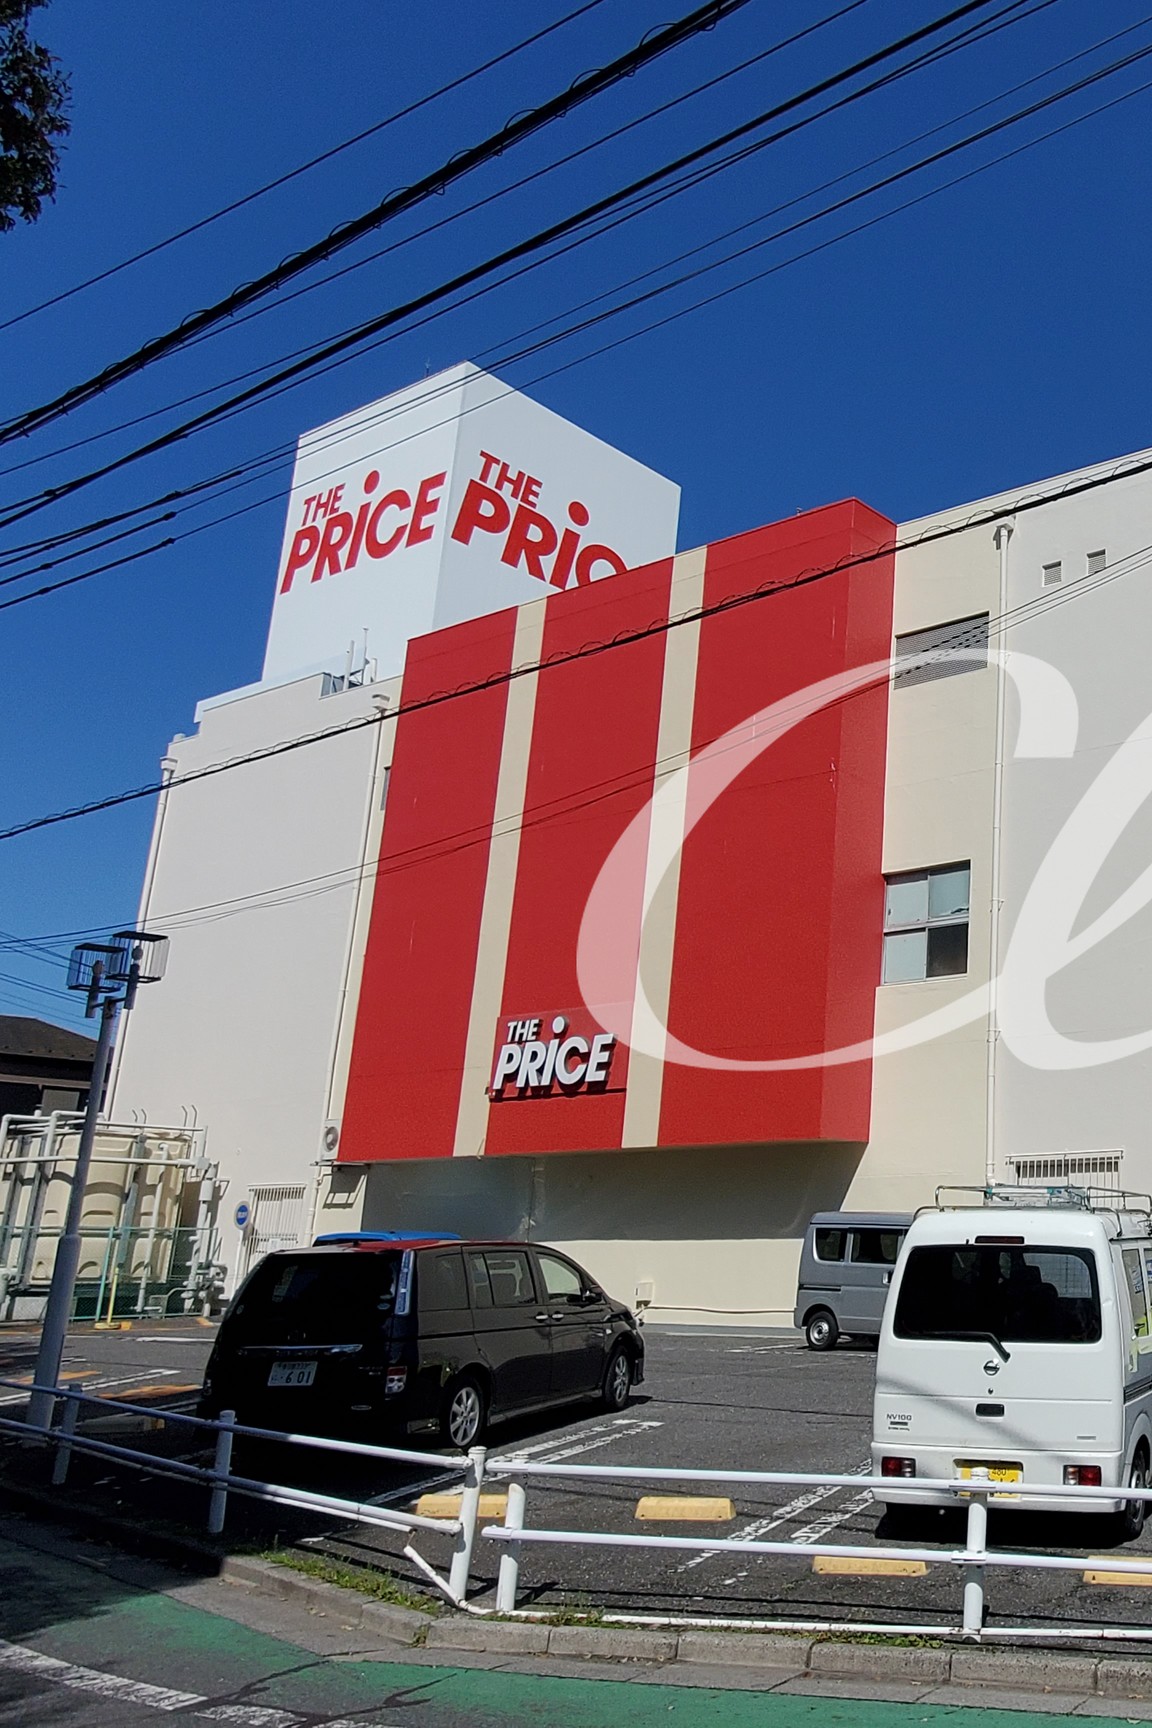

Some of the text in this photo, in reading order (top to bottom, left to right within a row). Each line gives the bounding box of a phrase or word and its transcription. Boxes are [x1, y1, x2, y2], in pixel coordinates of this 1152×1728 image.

[478, 449, 543, 509] THE
[302, 482, 346, 527] THE
[507, 1019, 541, 1043] THE
[886, 1413, 912, 1421] NV100
